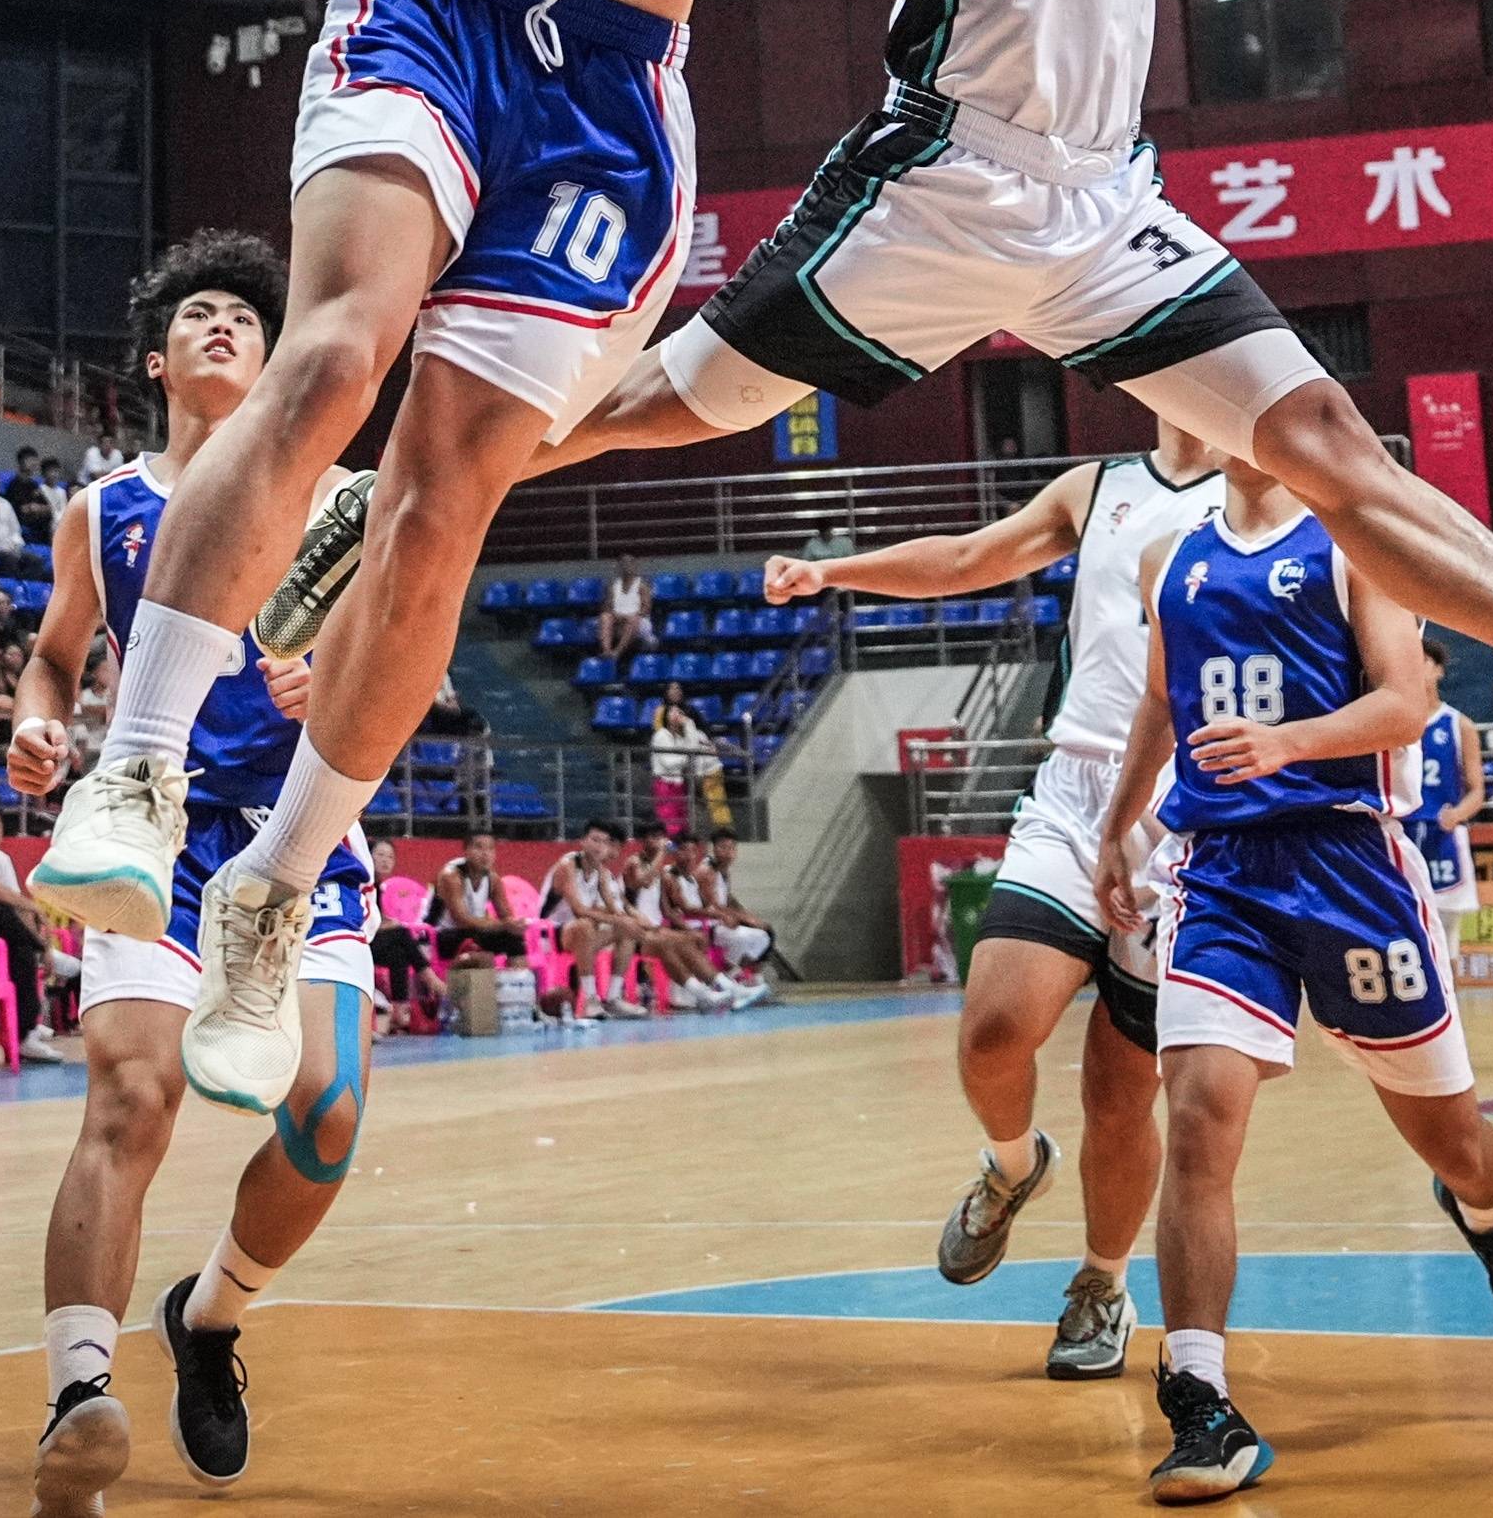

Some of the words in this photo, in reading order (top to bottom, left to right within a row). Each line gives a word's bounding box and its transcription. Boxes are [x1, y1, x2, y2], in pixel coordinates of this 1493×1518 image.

[1210, 145, 1453, 242] 艺术
[530, 181, 627, 284] 10
[1128, 223, 1195, 272] 3
[1281, 562, 1306, 580] FBA
[1201, 654, 1285, 724] 88
[1429, 859, 1456, 882] 12
[1344, 937, 1429, 1004] 88
